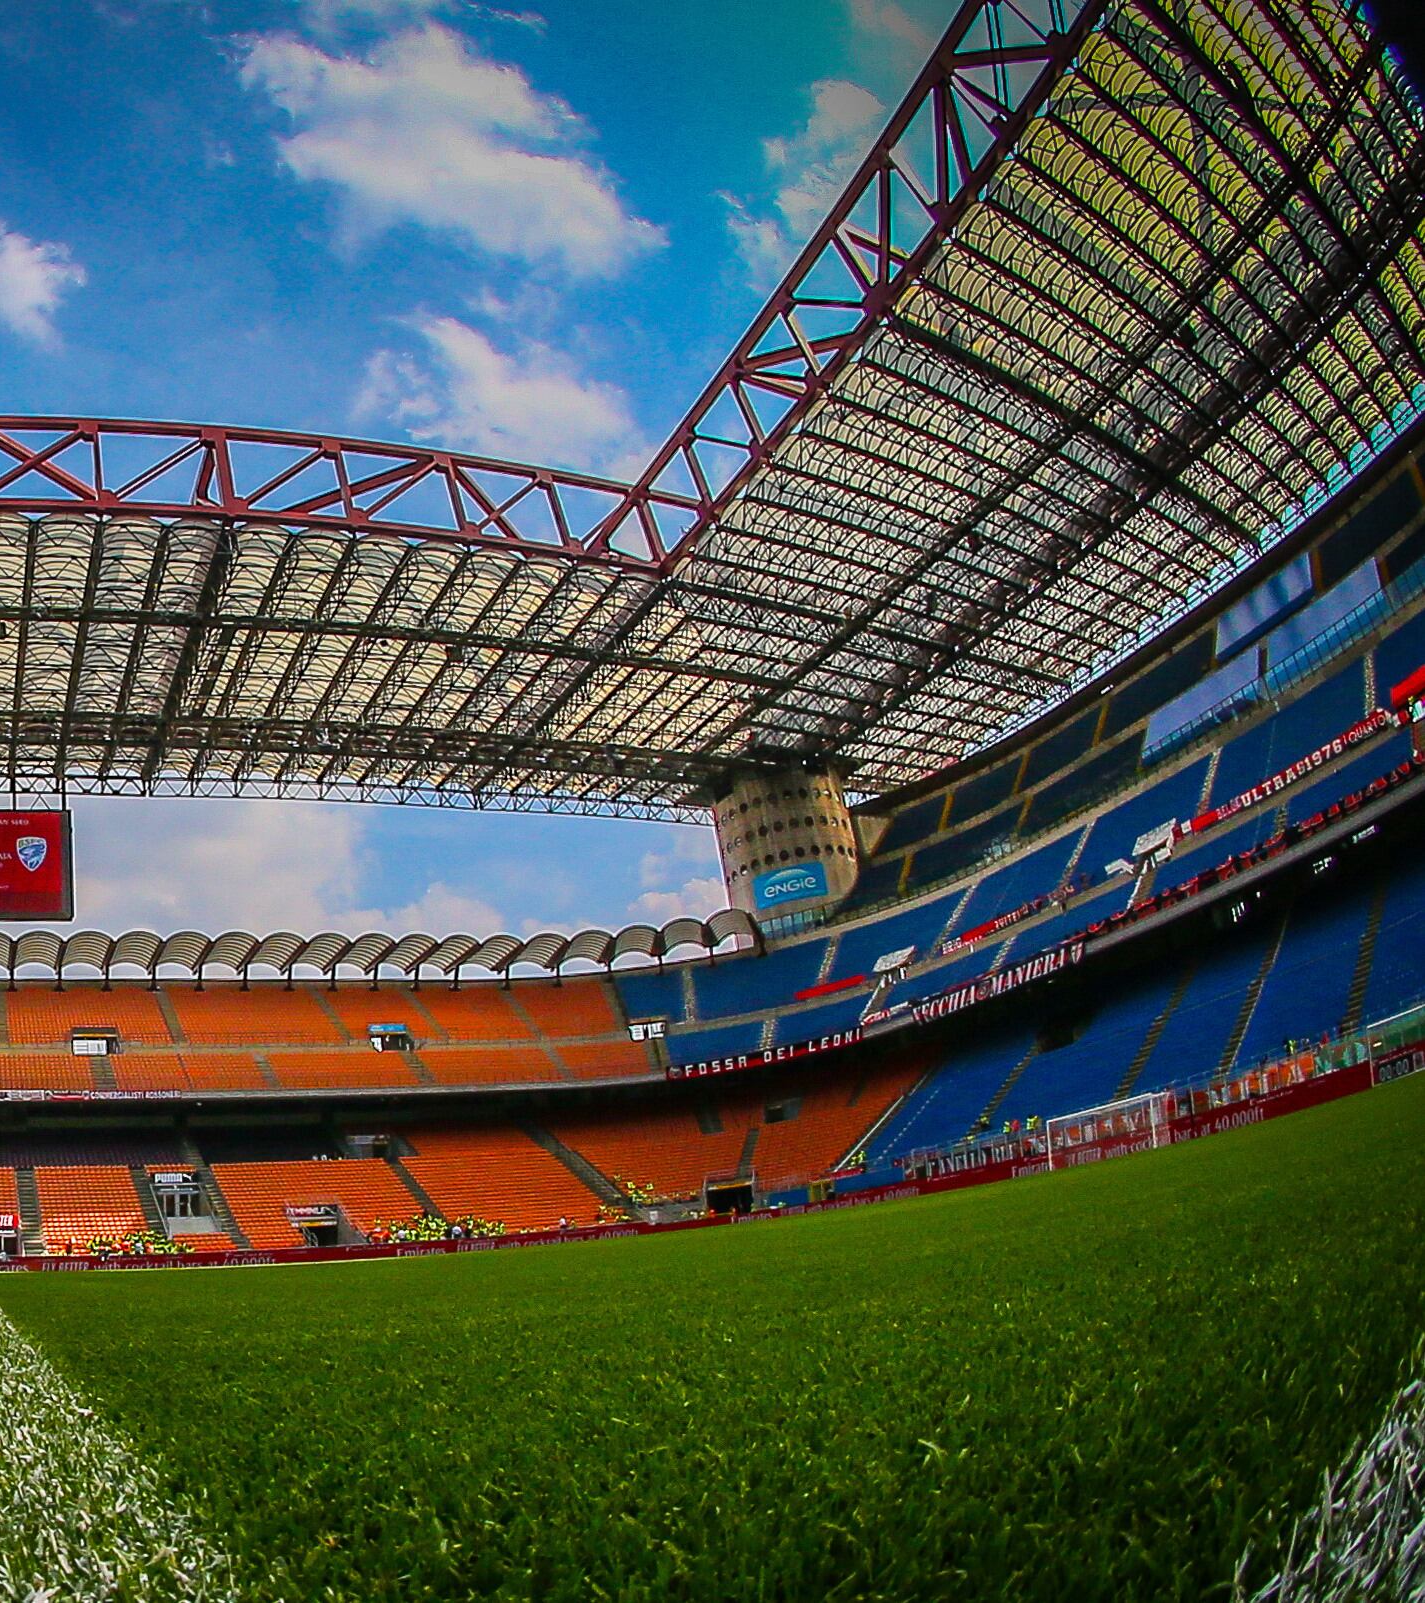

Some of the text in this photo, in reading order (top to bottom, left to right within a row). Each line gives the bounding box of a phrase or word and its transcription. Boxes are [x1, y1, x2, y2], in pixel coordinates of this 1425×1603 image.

[912, 947, 1065, 1025] VECCHIA MANIERA
[685, 1028, 861, 1077] FOSSA DEI LEONI
[155, 1173, 182, 1183] PUMA
[396, 1247, 446, 1257] Emirates
[93, 1260, 120, 1270] with
[124, 1260, 173, 1270] cocktail
